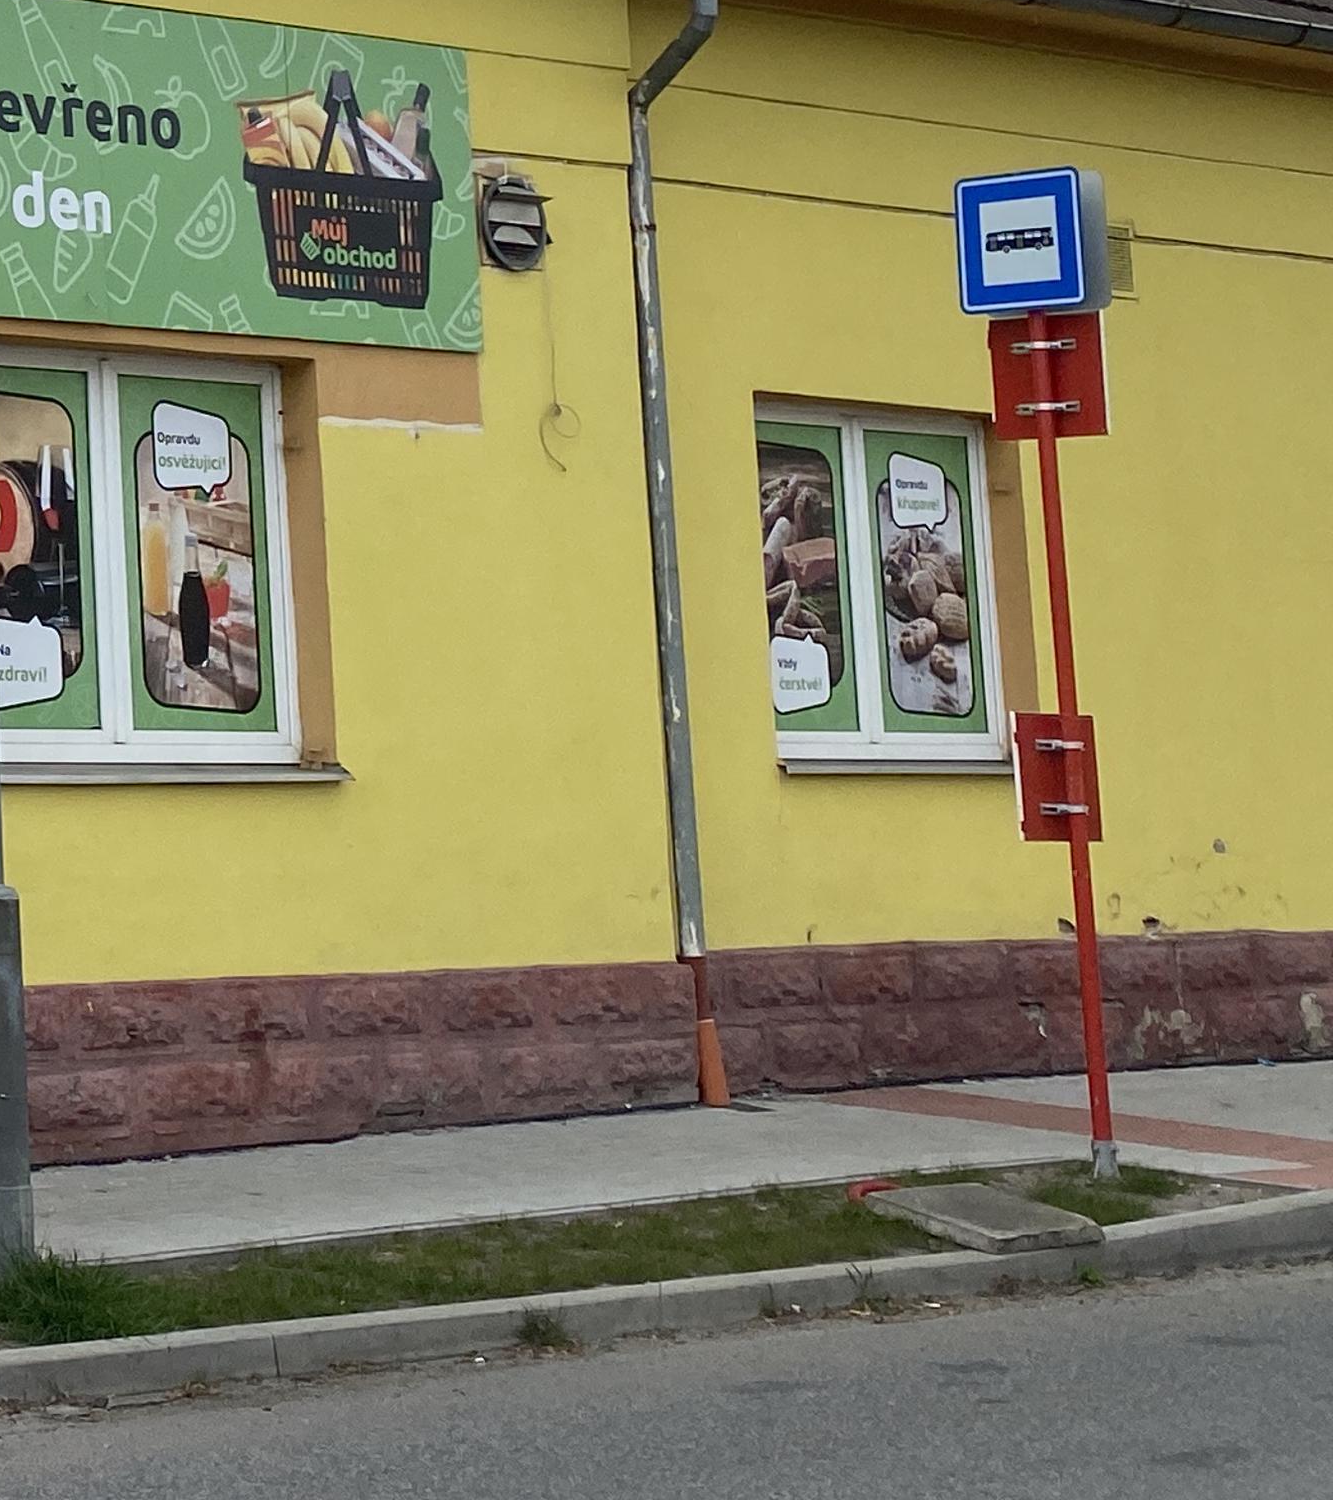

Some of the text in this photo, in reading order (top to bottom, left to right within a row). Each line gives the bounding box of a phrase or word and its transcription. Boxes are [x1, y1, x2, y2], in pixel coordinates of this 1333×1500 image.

[12, 170, 112, 235] den
[311, 215, 349, 247] Můj
[323, 244, 398, 270] obchod
[156, 431, 201, 446] Opravdu
